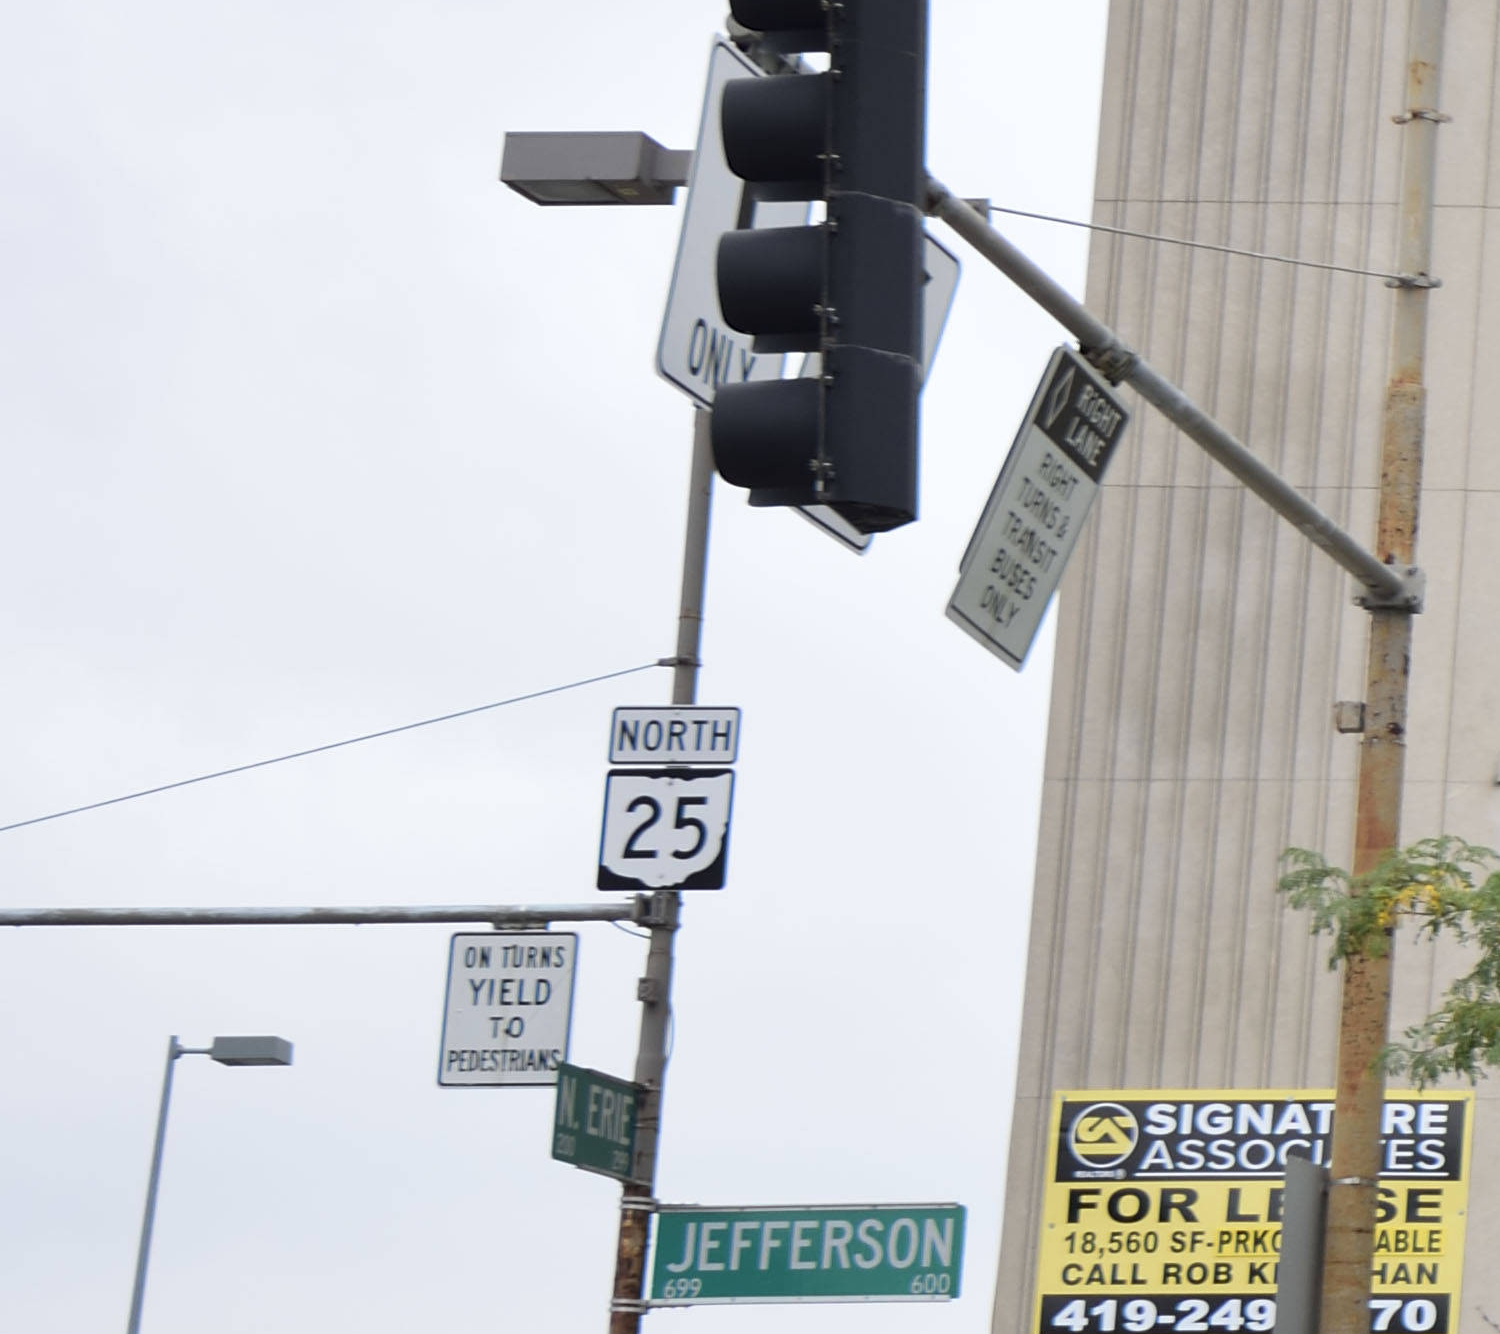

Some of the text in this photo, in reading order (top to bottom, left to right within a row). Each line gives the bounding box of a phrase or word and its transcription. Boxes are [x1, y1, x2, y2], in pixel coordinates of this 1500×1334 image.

[1077, 383, 1122, 438] RIGHT
[1063, 416, 1106, 467] LANE
[1038, 453, 1079, 500] RIGHT
[1017, 477, 1061, 530] TURNS
[1002, 510, 1057, 572] TRANSIT
[990, 548, 1038, 600] BUSES
[979, 585, 1021, 628] ONLY
[618, 720, 732, 752] NORTH
[622, 795, 708, 860] 25
[464, 946, 566, 969] ON TURNS
[469, 979, 552, 1006] YIELD
[489, 1017, 525, 1039] TO
[447, 1049, 561, 1072] PEDESTRIANS
[587, 1084, 634, 1146] ERIE
[1143, 1102, 1449, 1135] SIGNATRE
[1138, 1139, 1446, 1171] ASSOCIES
[1067, 1187, 1443, 1224] FOR LSE
[666, 1218, 954, 1273] JEFFERSON
[1065, 1230, 1159, 1258] 18,560
[663, 1274, 951, 1299] 699 600
[1062, 1262, 1147, 1286] CALL
[1162, 1262, 1233, 1285] ROB
